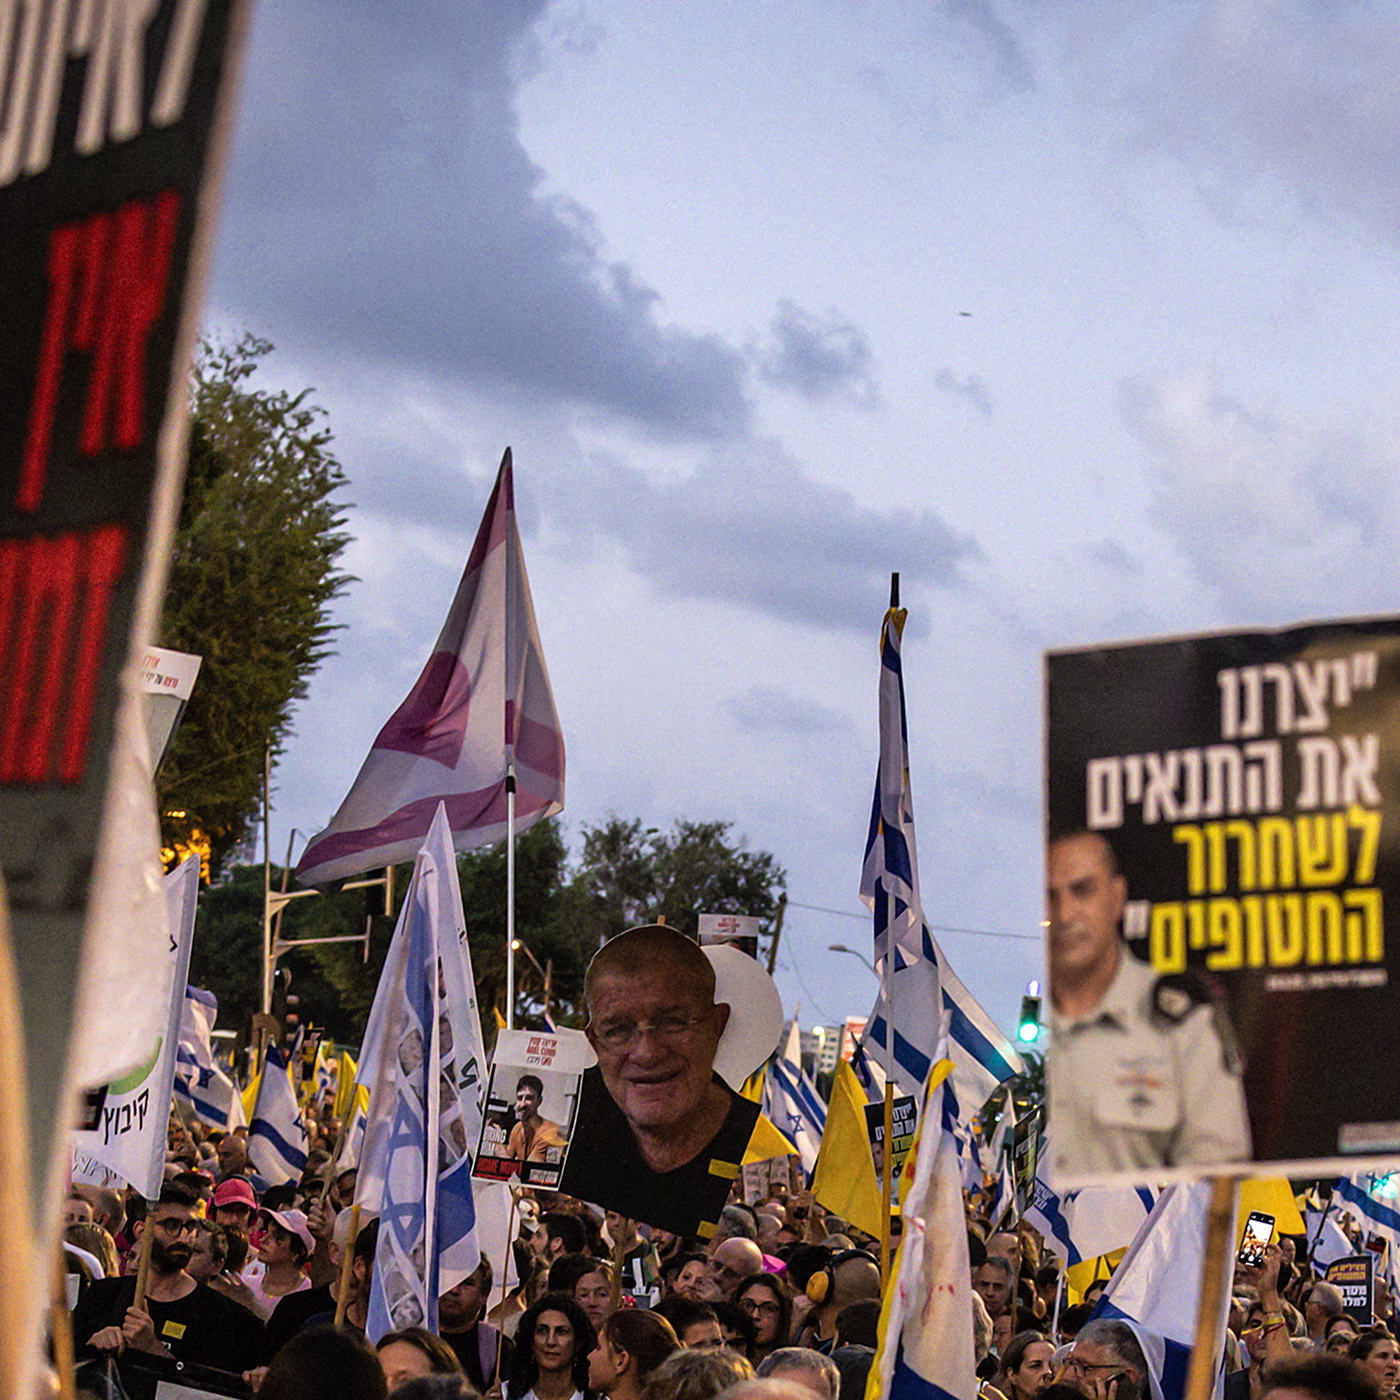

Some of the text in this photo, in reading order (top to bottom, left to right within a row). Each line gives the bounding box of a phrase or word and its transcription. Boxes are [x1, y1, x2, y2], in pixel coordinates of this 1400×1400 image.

[1086, 734, 1383, 830] את התנאים
[1172, 804, 1384, 895] לשחרור
[104, 1088, 150, 1145] קיבוץ
